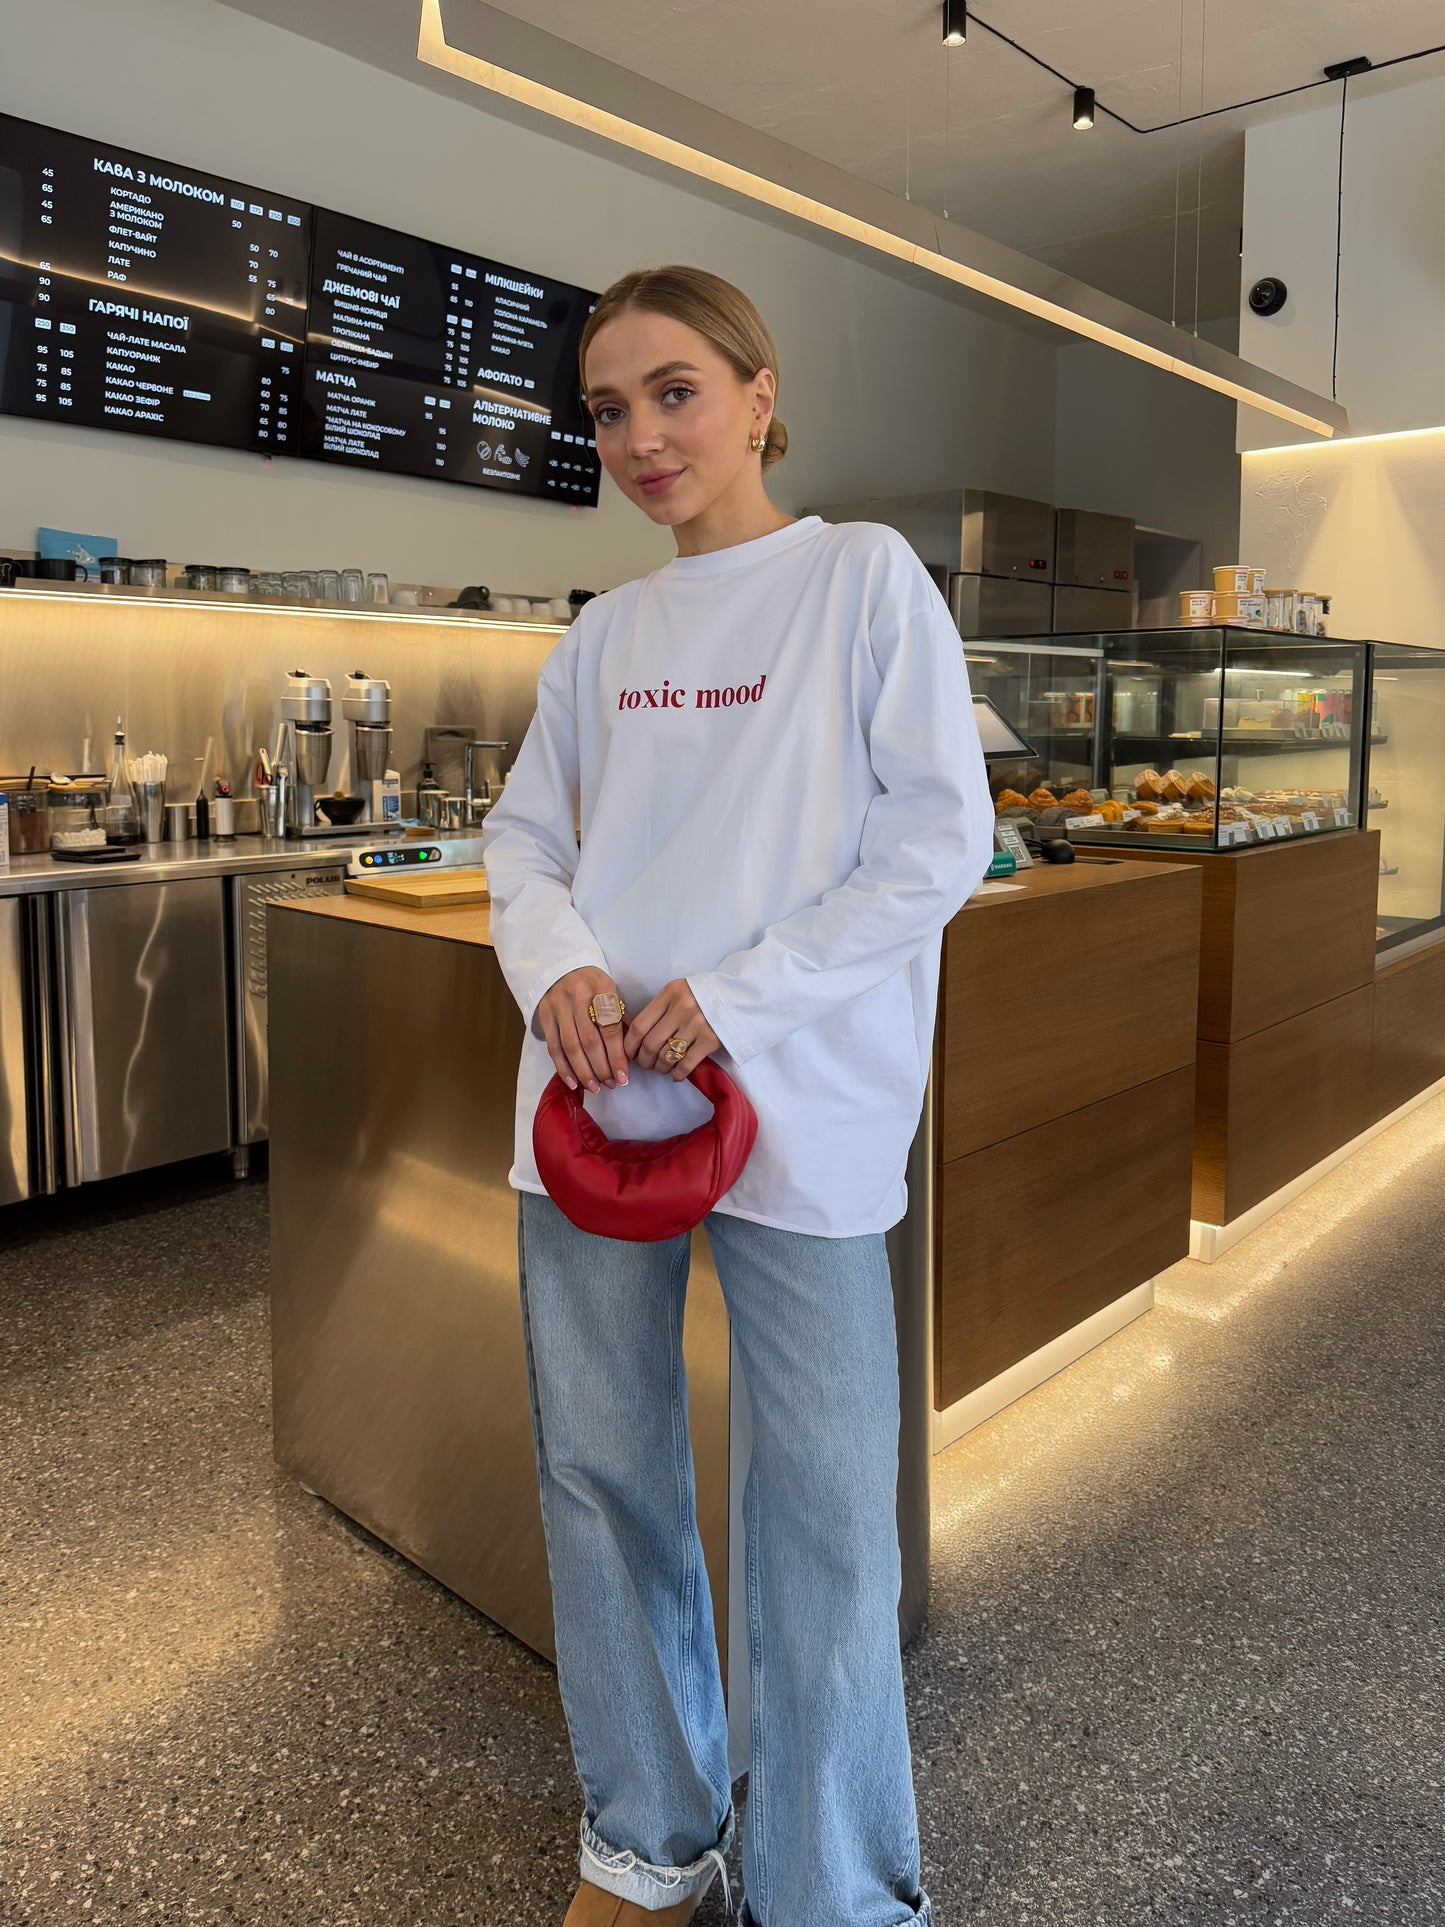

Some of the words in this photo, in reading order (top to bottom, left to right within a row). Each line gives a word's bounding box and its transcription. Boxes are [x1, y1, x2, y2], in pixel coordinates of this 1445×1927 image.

[42, 168, 54, 177] 45
[42, 184, 53, 193] 65
[94, 158, 134, 180] КАВА
[150, 174, 224, 206] МОЛОКОМ
[110, 187, 152, 204] КОРТАДО
[41, 200, 53, 209] 45
[109, 201, 165, 221] АМЕРИКАНО
[41, 215, 52, 224] 65
[117, 211, 162, 230] МОЛОКОМ
[231, 220, 242, 229] 50
[109, 225, 158, 244] ФЛЕТ-ВАЙТ
[108, 240, 157, 259] КАПУЧИНО
[249, 244, 260, 252] 50
[268, 249, 278, 257] 70
[337, 249, 352, 260] ЧАЙ
[40, 262, 51, 270] 65
[107, 255, 131, 268] ЛАТЕ
[249, 260, 259, 269] 70
[107, 271, 127, 282] РАФ
[336, 263, 372, 279] ГРЕЧАНИЙ
[373, 273, 387, 283] ЧАЙ
[39, 277, 51, 286] 90
[248, 274, 258, 283] 55
[267, 280, 277, 288] 75
[485, 273, 544, 299] МІЛКШЕЙКИ
[38, 293, 50, 302] 90
[322, 279, 378, 303] ДЖЕМОВІ
[380, 294, 400, 309] ЧАЇ
[88, 298, 139, 320] ГАРЯЧІ
[142, 310, 190, 331] НАПОЇ
[265, 307, 275, 316] 80
[332, 326, 370, 341] ТРОПІКАНА
[107, 331, 150, 347] ЧАЙ-ЛАТЕ
[151, 340, 187, 354] МАСАЛА
[37, 345, 48, 354] 95
[59, 349, 74, 359] 105
[106, 346, 161, 364] КАПУОРАНЖ
[36, 363, 48, 372] 75
[60, 367, 72, 376] 85
[106, 361, 135, 373] КАКАО
[281, 366, 290, 375] 75
[261, 377, 271, 385] 80
[316, 370, 357, 388] МАТЧА
[477, 367, 523, 387] АФОГАТО
[36, 378, 47, 387] 75
[60, 382, 71, 391] 85
[105, 376, 135, 388] КАКАО
[136, 381, 174, 395] ЧЕРВОНЕ
[35, 393, 47, 402] 95
[58, 397, 73, 406] 105
[105, 391, 134, 402] КАКАО
[135, 395, 160, 407] ЗЕФІР
[279, 394, 288, 402] 75
[327, 391, 350, 402] МАТЧА
[351, 396, 376, 408] ОРАНЖ
[104, 405, 134, 417] КАКАО
[135, 411, 164, 422] АРАХІС
[260, 403, 270, 411] 70
[326, 404, 349, 415] МАТЧА
[350, 409, 367, 419] ЛАТЕ
[473, 399, 552, 425] АЛЬТЕРНАТИВНЕ
[351, 420, 362, 428] НА
[472, 413, 515, 430] МОЛОКО
[347, 428, 381, 441] ШОКОЛАД
[324, 435, 347, 445] МАТЧА
[348, 439, 365, 448] ЛАТЕ
[345, 446, 379, 459] ШОКОЛАД
[618, 680, 686, 711] toxic
[695, 674, 767, 709] mood
[306, 875, 340, 885] POLAIR
